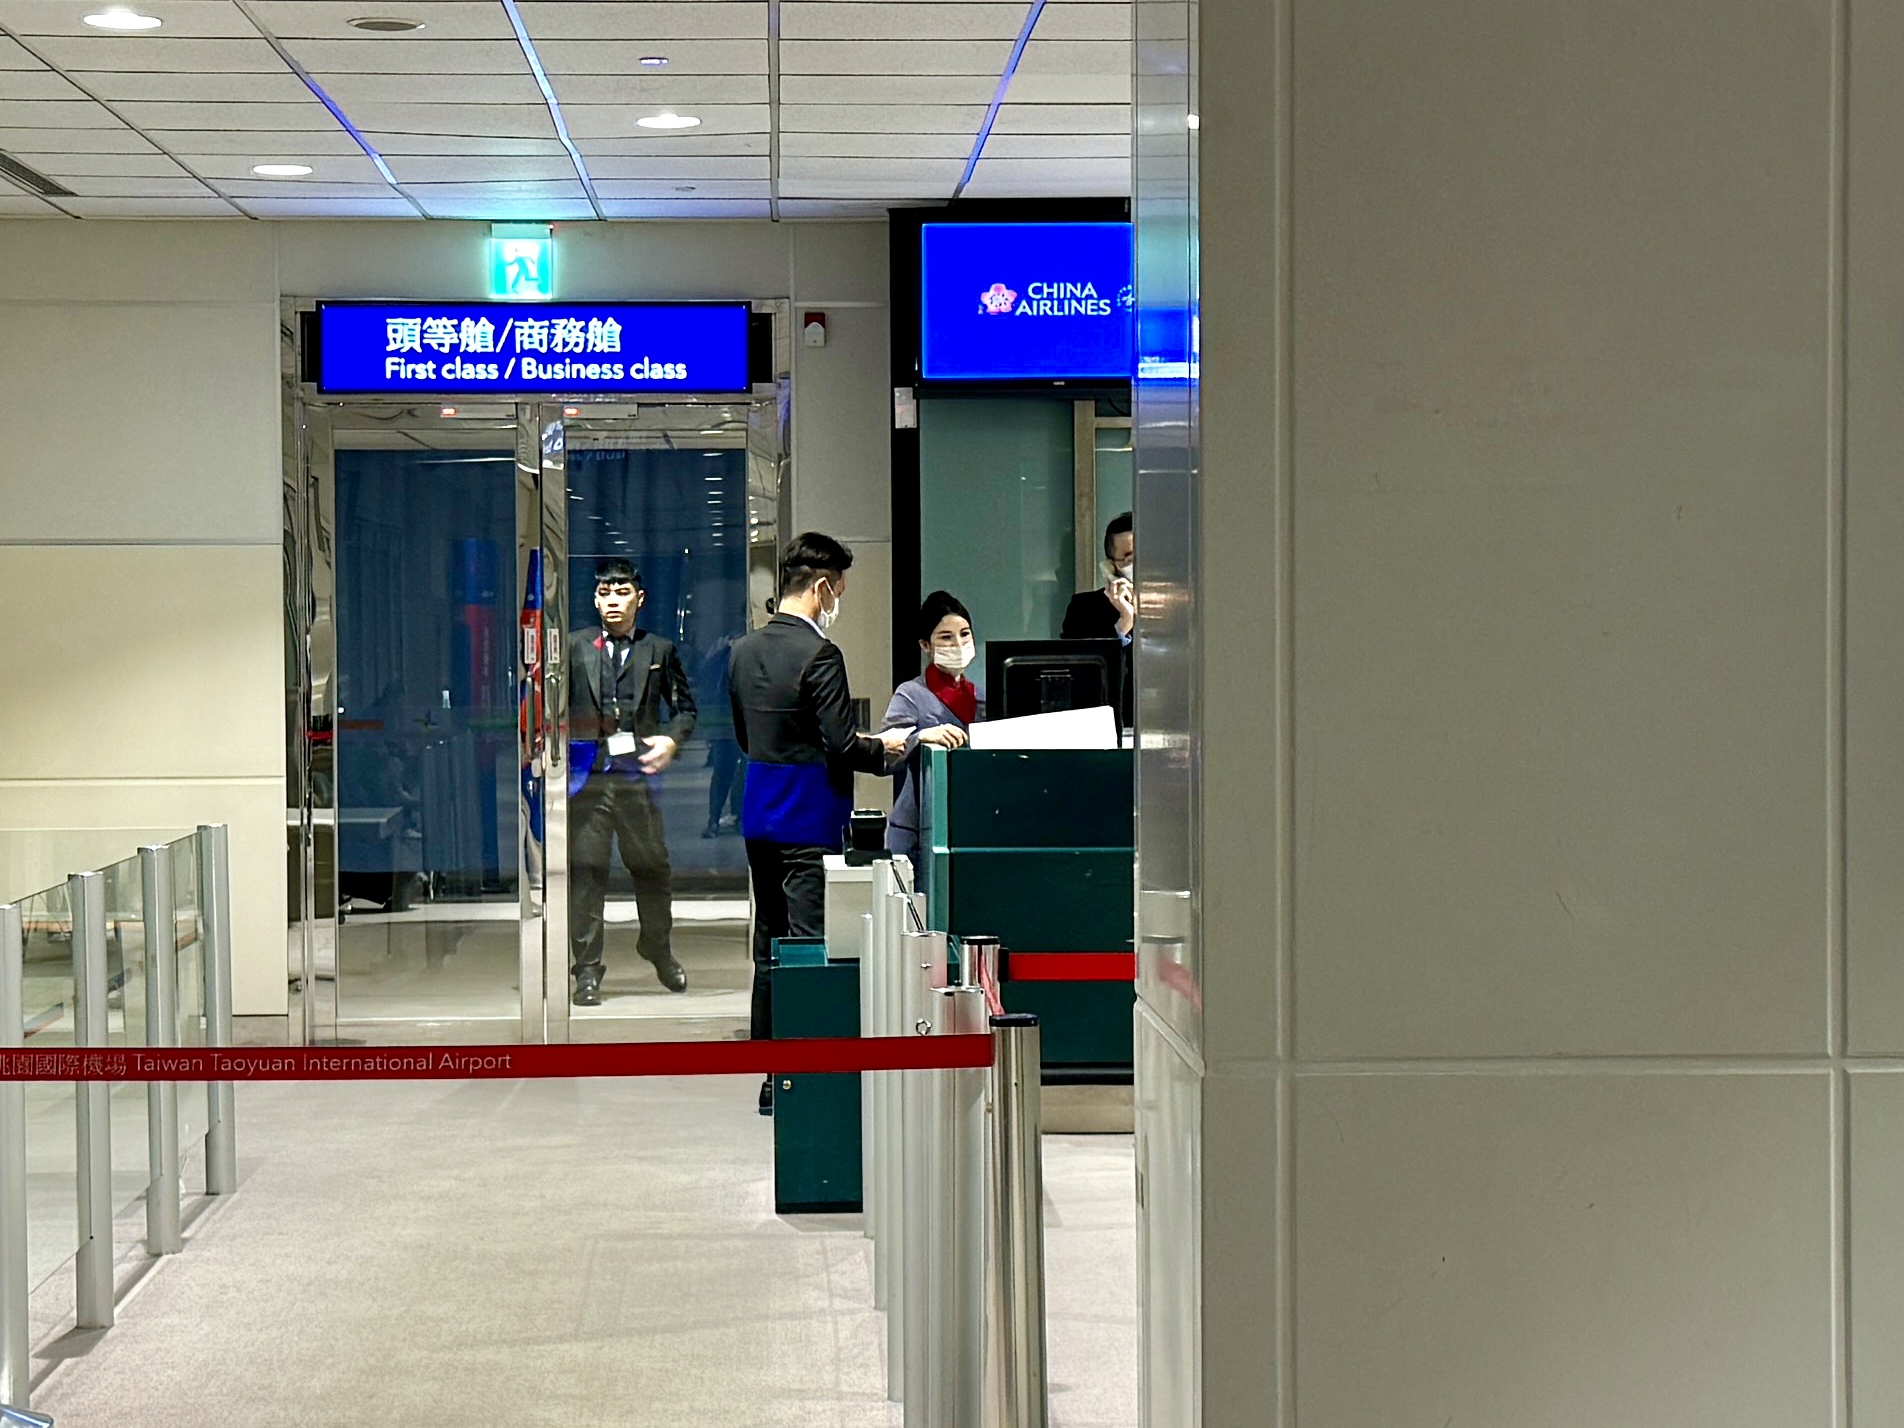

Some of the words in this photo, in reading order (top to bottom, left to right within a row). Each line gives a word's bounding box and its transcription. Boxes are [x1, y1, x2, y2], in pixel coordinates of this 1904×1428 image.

[1027, 281, 1098, 299] CHINA
[1015, 299, 1112, 316] AIRLINES
[385, 316, 623, 353] 頭等艙/商務艙
[385, 357, 437, 380] First
[441, 356, 499, 380] class
[521, 357, 625, 380] Business
[629, 356, 688, 380] class
[132, 1053, 204, 1072] Taiwan
[209, 1053, 296, 1076] Taoyuan
[303, 1051, 433, 1072] International
[438, 1052, 513, 1075] Airport
